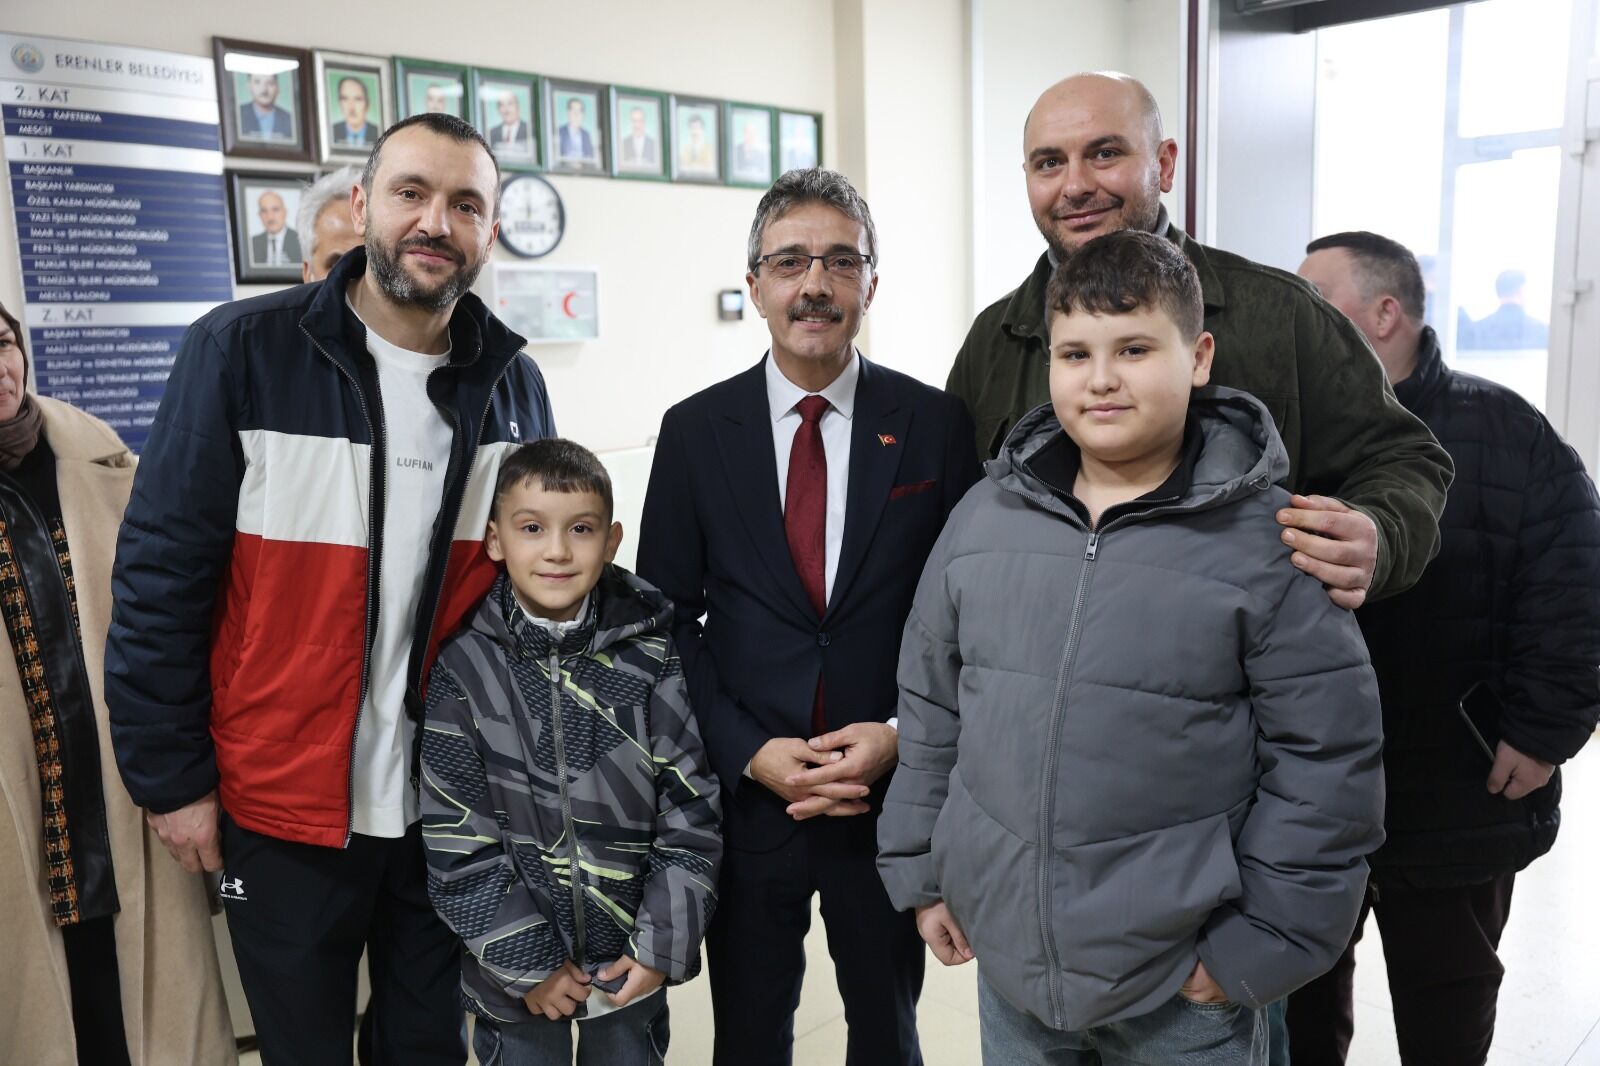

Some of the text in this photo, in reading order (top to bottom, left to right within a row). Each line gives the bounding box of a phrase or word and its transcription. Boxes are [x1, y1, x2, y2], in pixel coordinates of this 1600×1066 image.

[56, 54, 124, 73] ERENLER
[38, 87, 71, 103] KAT
[17, 108, 45, 119] TERAS
[53, 110, 102, 122] KAFETERYA
[43, 142, 75, 158] KAT
[64, 309, 95, 321] KAT
[396, 457, 433, 472] LUFIAN
